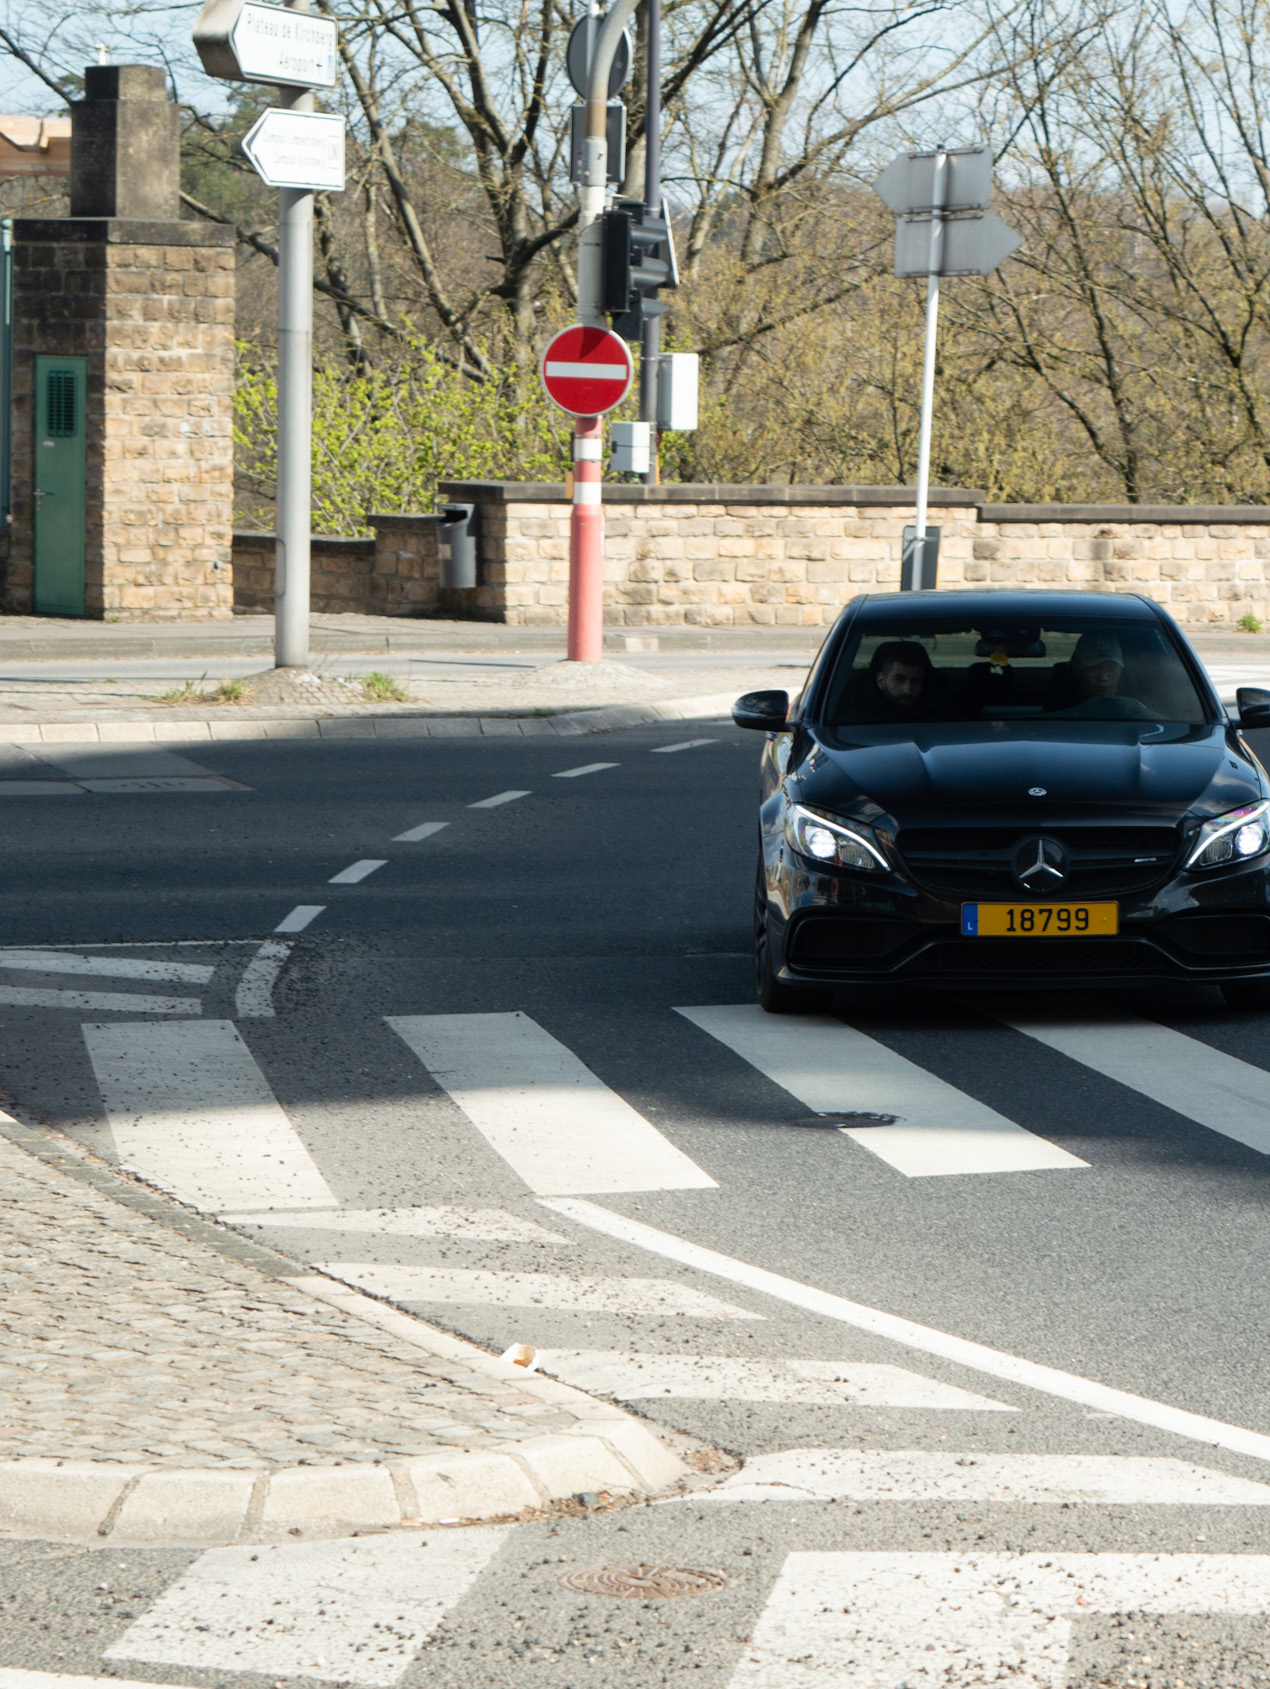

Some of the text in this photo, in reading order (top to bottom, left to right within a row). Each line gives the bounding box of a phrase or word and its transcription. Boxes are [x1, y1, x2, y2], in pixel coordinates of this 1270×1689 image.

[246, 12, 333, 51] Plateau de Kirchberg
[967, 921, 974, 931] L
[1006, 907, 1089, 932] 18799
